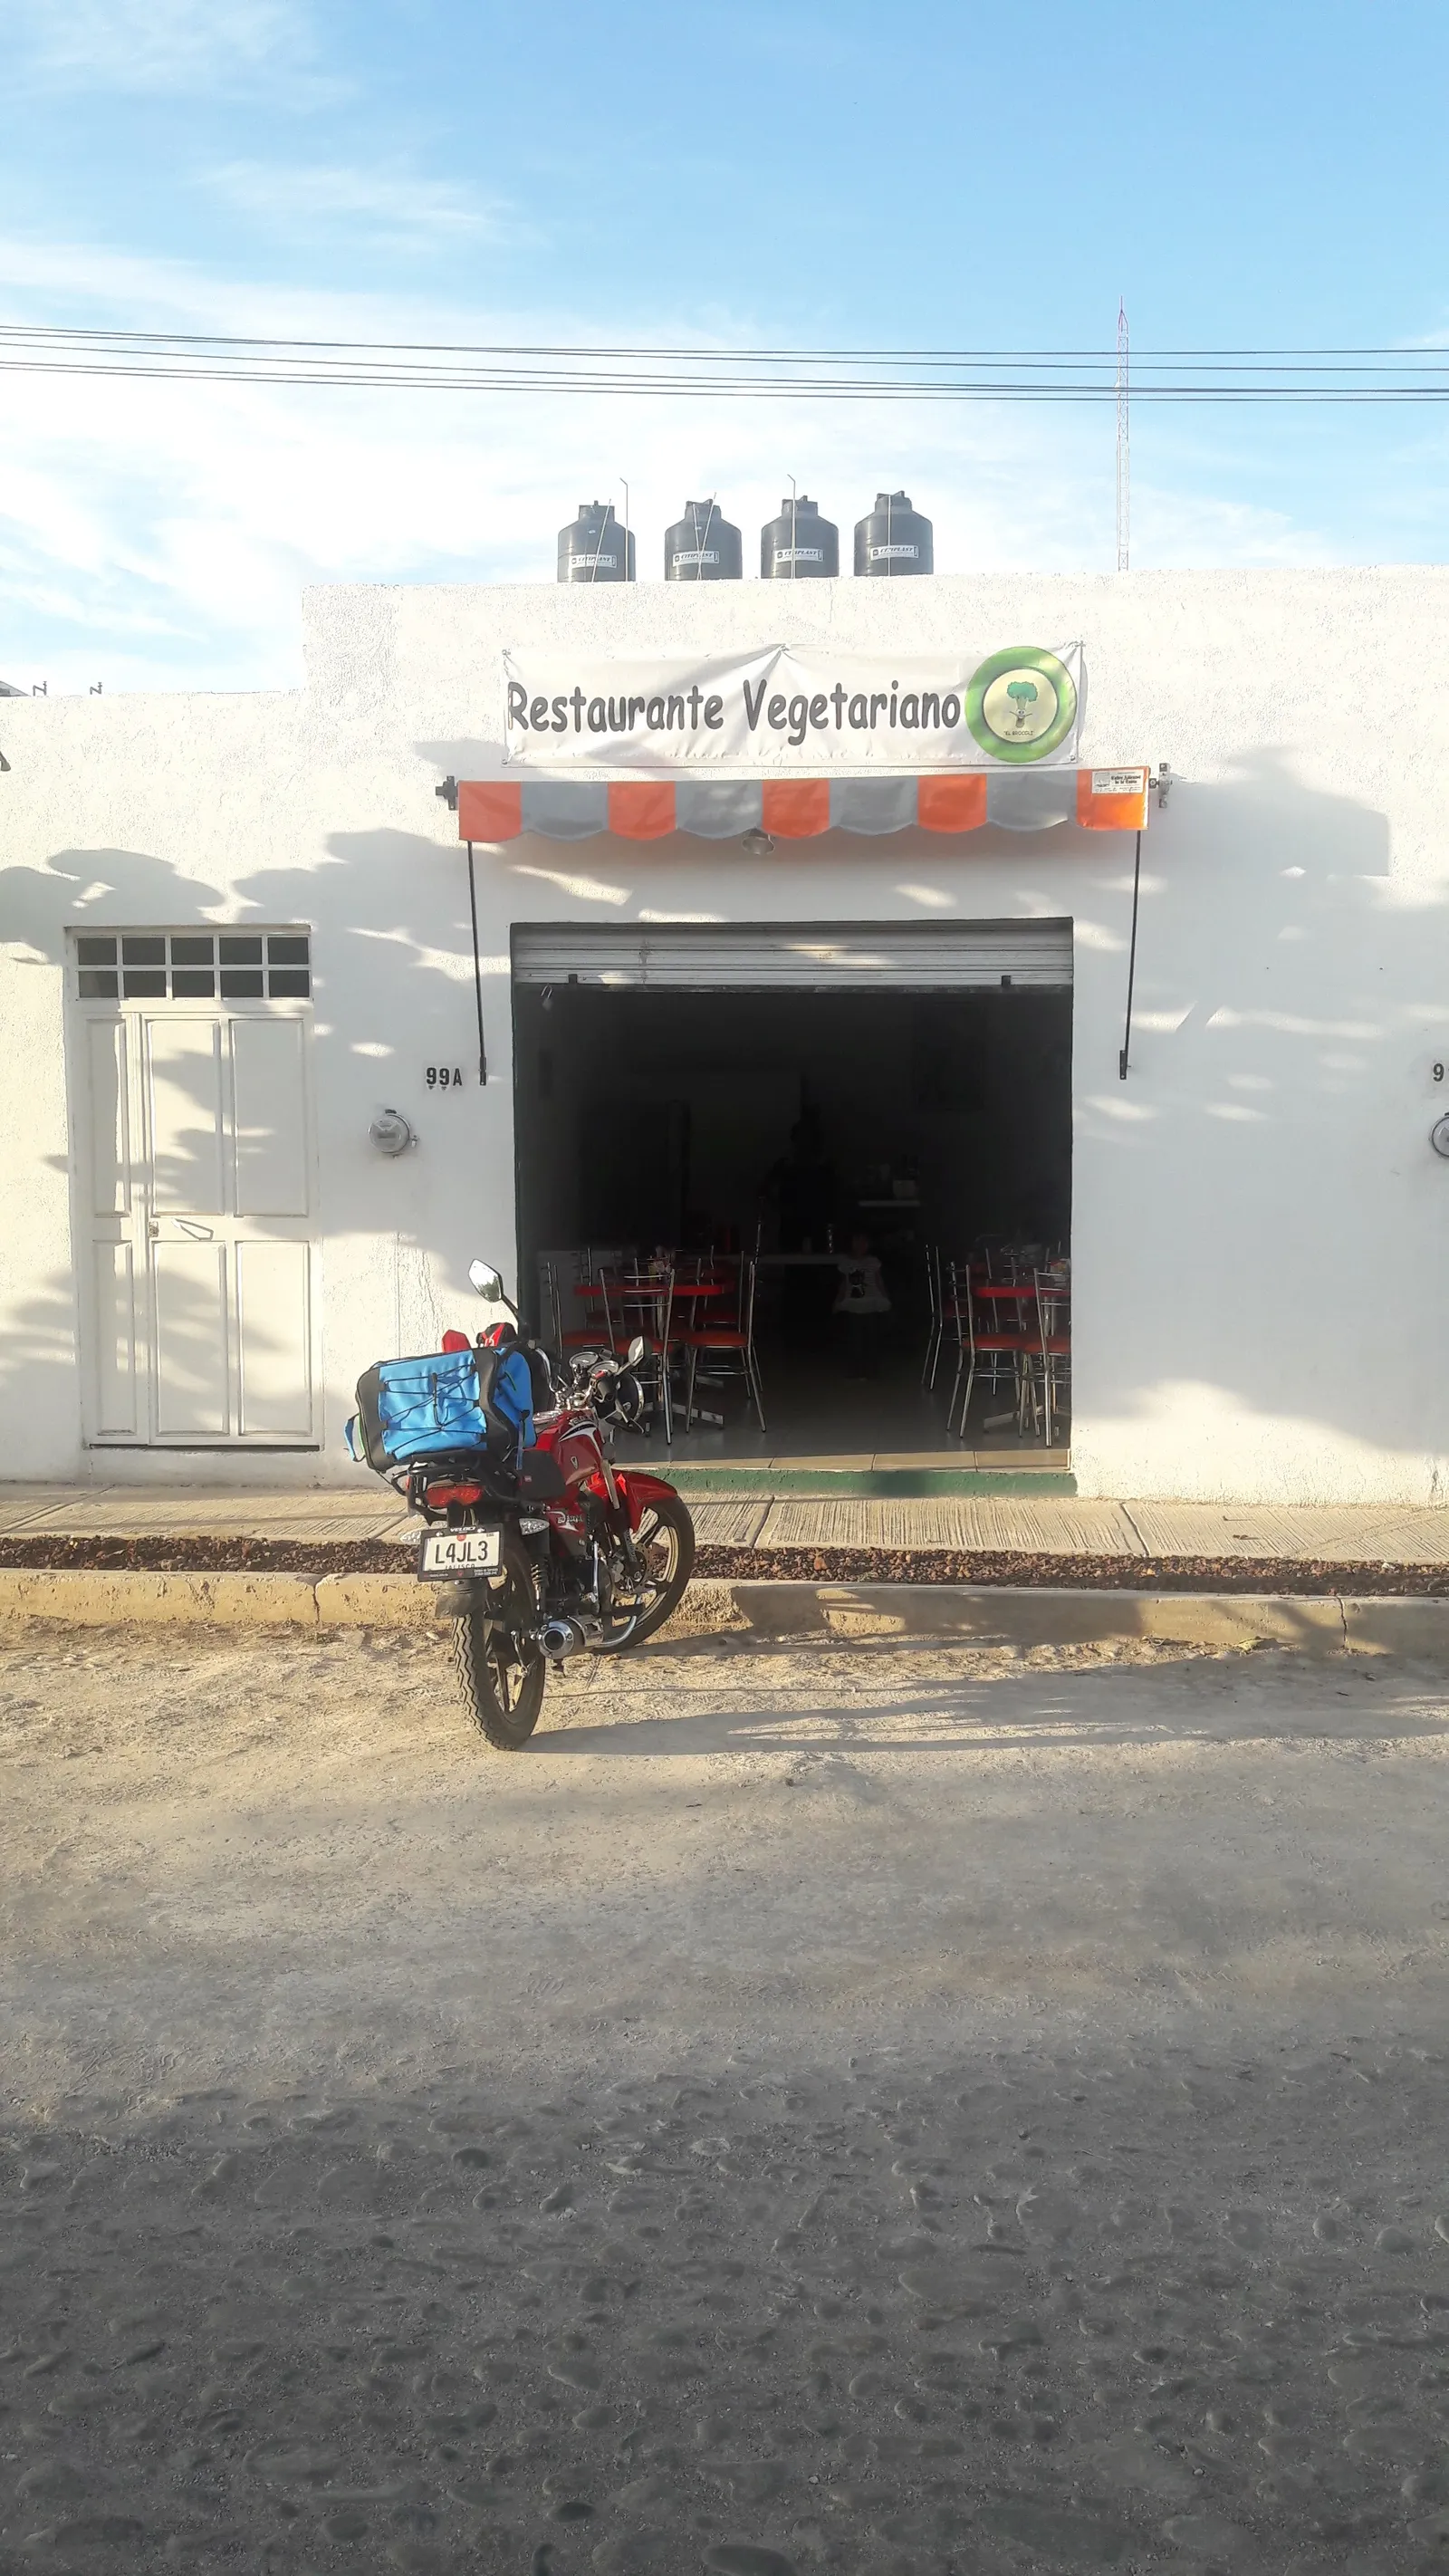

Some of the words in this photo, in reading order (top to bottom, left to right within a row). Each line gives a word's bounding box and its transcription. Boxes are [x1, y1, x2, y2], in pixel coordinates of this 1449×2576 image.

[507, 680, 724, 733] Restaurante
[743, 679, 961, 745] Vegetariano
[426, 1067, 463, 1086] 99A
[435, 1540, 488, 1564] L4JL3
